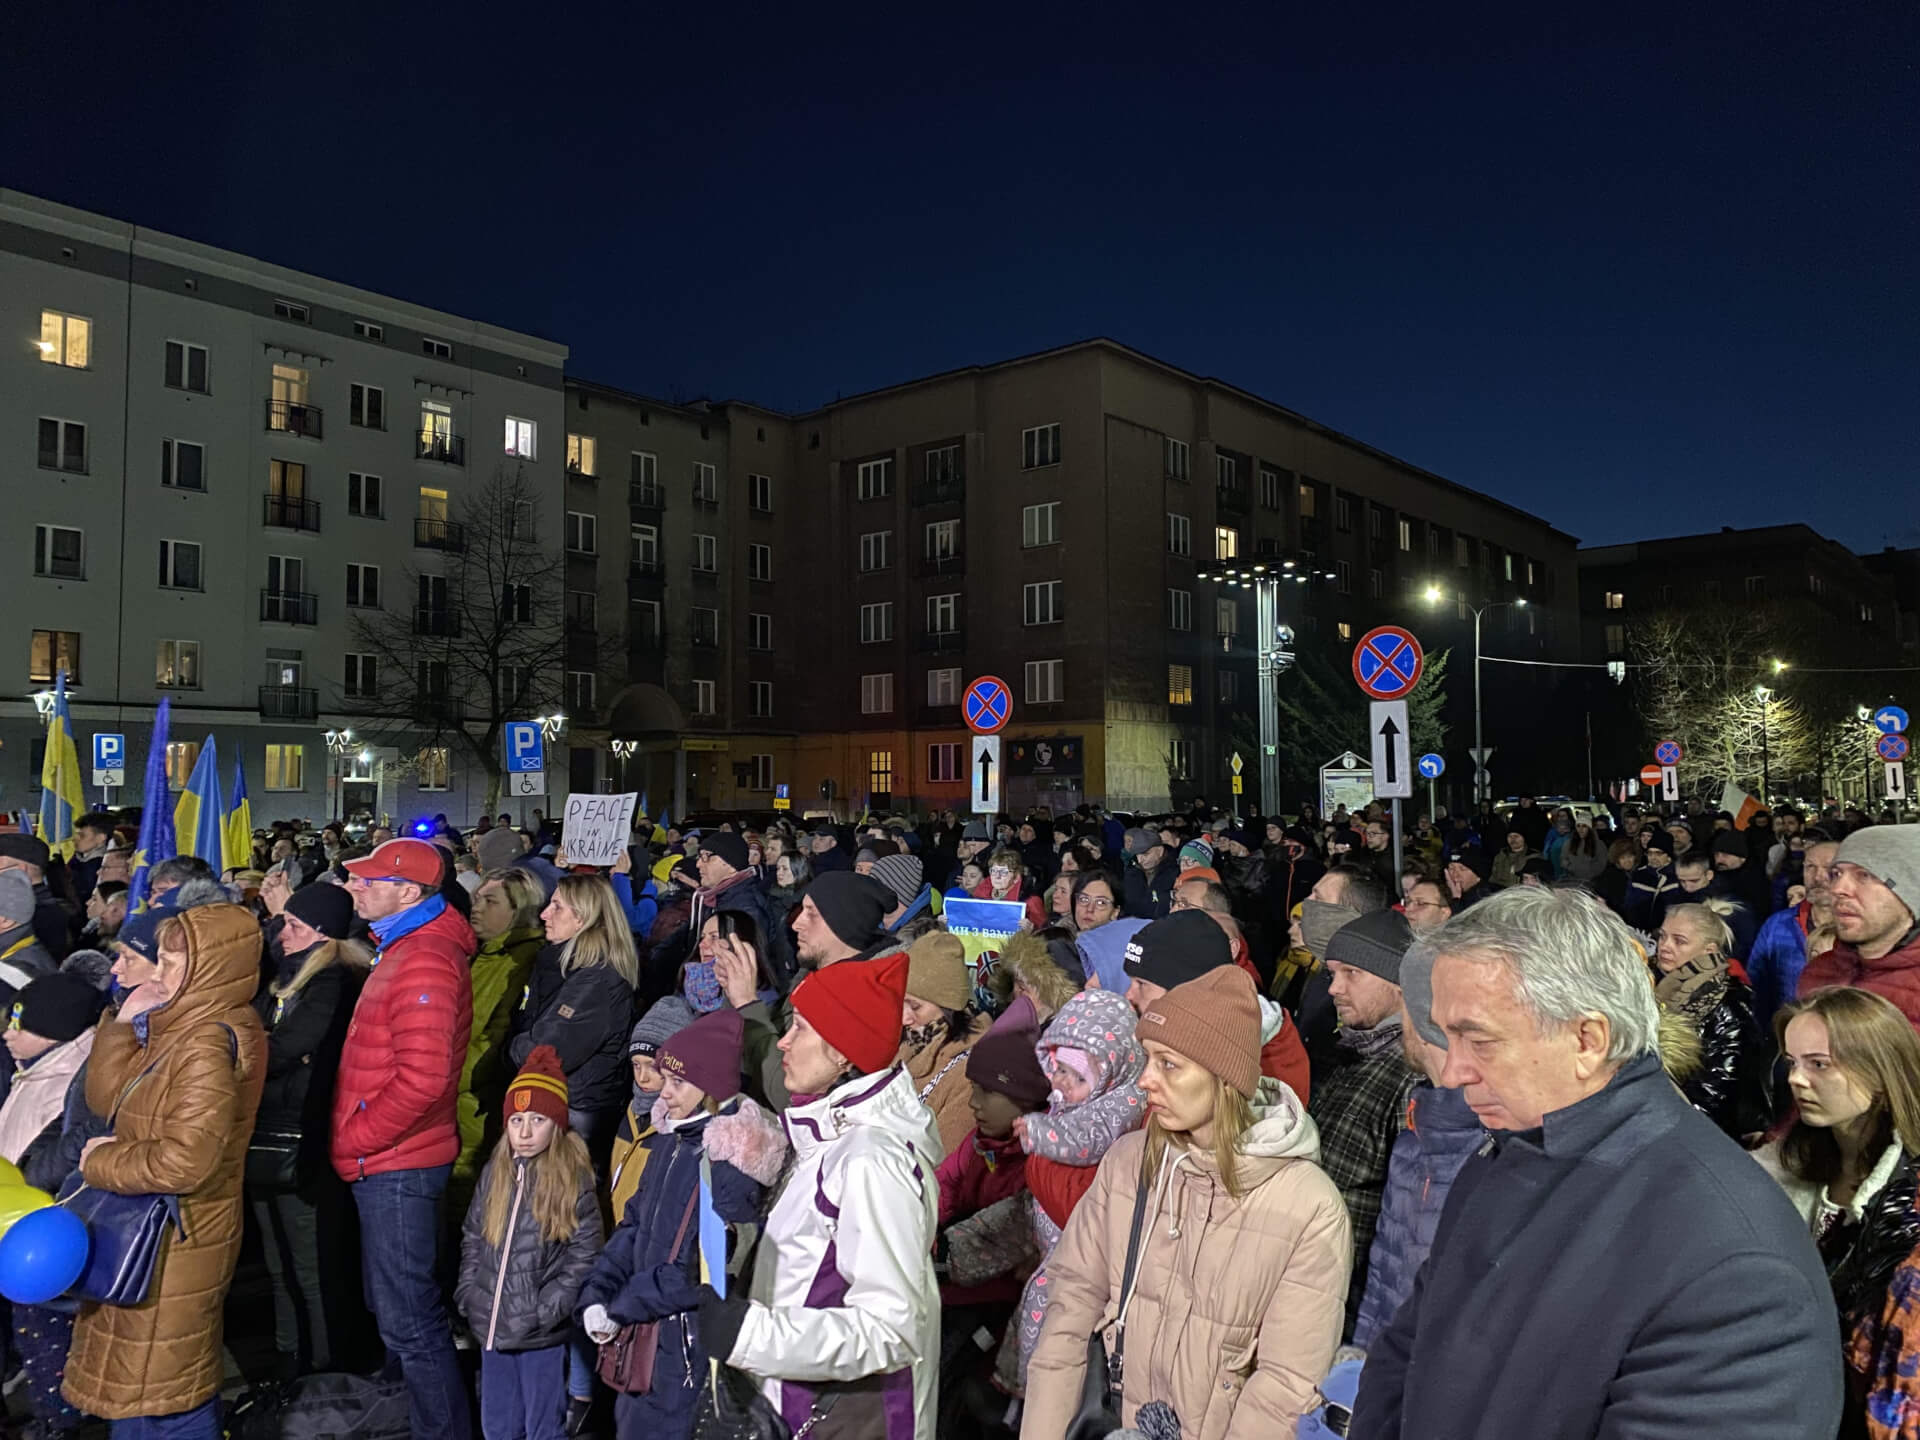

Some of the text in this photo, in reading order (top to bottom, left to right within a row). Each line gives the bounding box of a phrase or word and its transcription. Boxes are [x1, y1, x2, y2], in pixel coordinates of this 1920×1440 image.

[101, 737, 118, 759] P
[514, 726, 535, 758] P
[569, 797, 633, 822] PEACE
